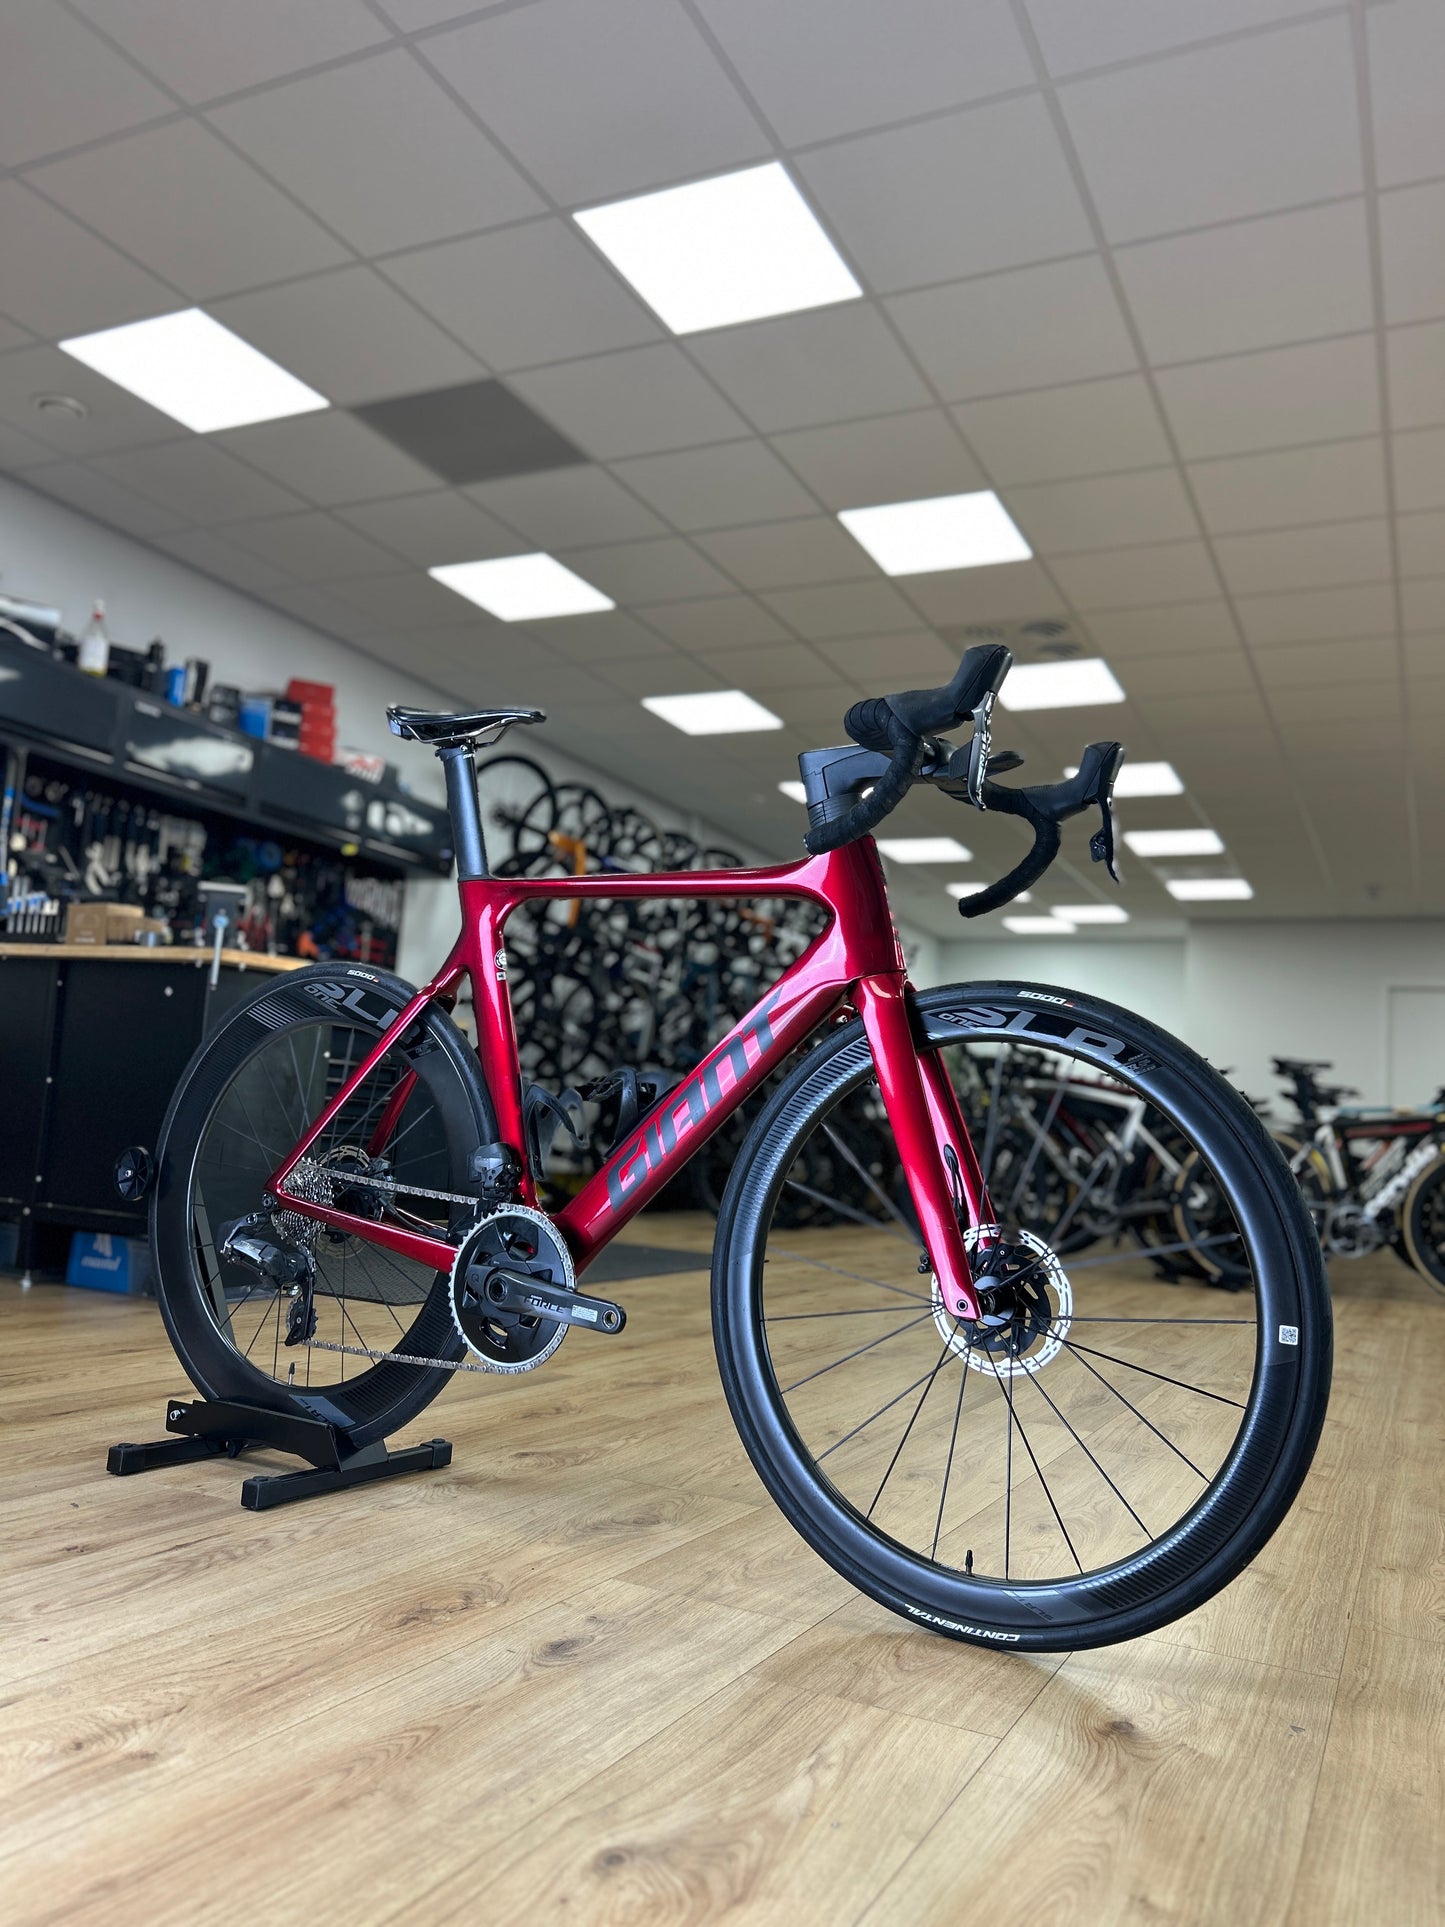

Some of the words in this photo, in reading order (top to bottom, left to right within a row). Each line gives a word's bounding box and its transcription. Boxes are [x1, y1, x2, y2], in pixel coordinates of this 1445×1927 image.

[347, 969, 376, 980] 5000
[304, 984, 343, 1009] ONE
[1017, 990, 1067, 1005] 5000
[938, 1012, 981, 1030] ONE
[952, 1006, 1127, 1064] SLR
[607, 984, 784, 1213] GIANT
[523, 1297, 564, 1314] FORCE
[905, 1604, 1021, 1642] CONTINENTAL
